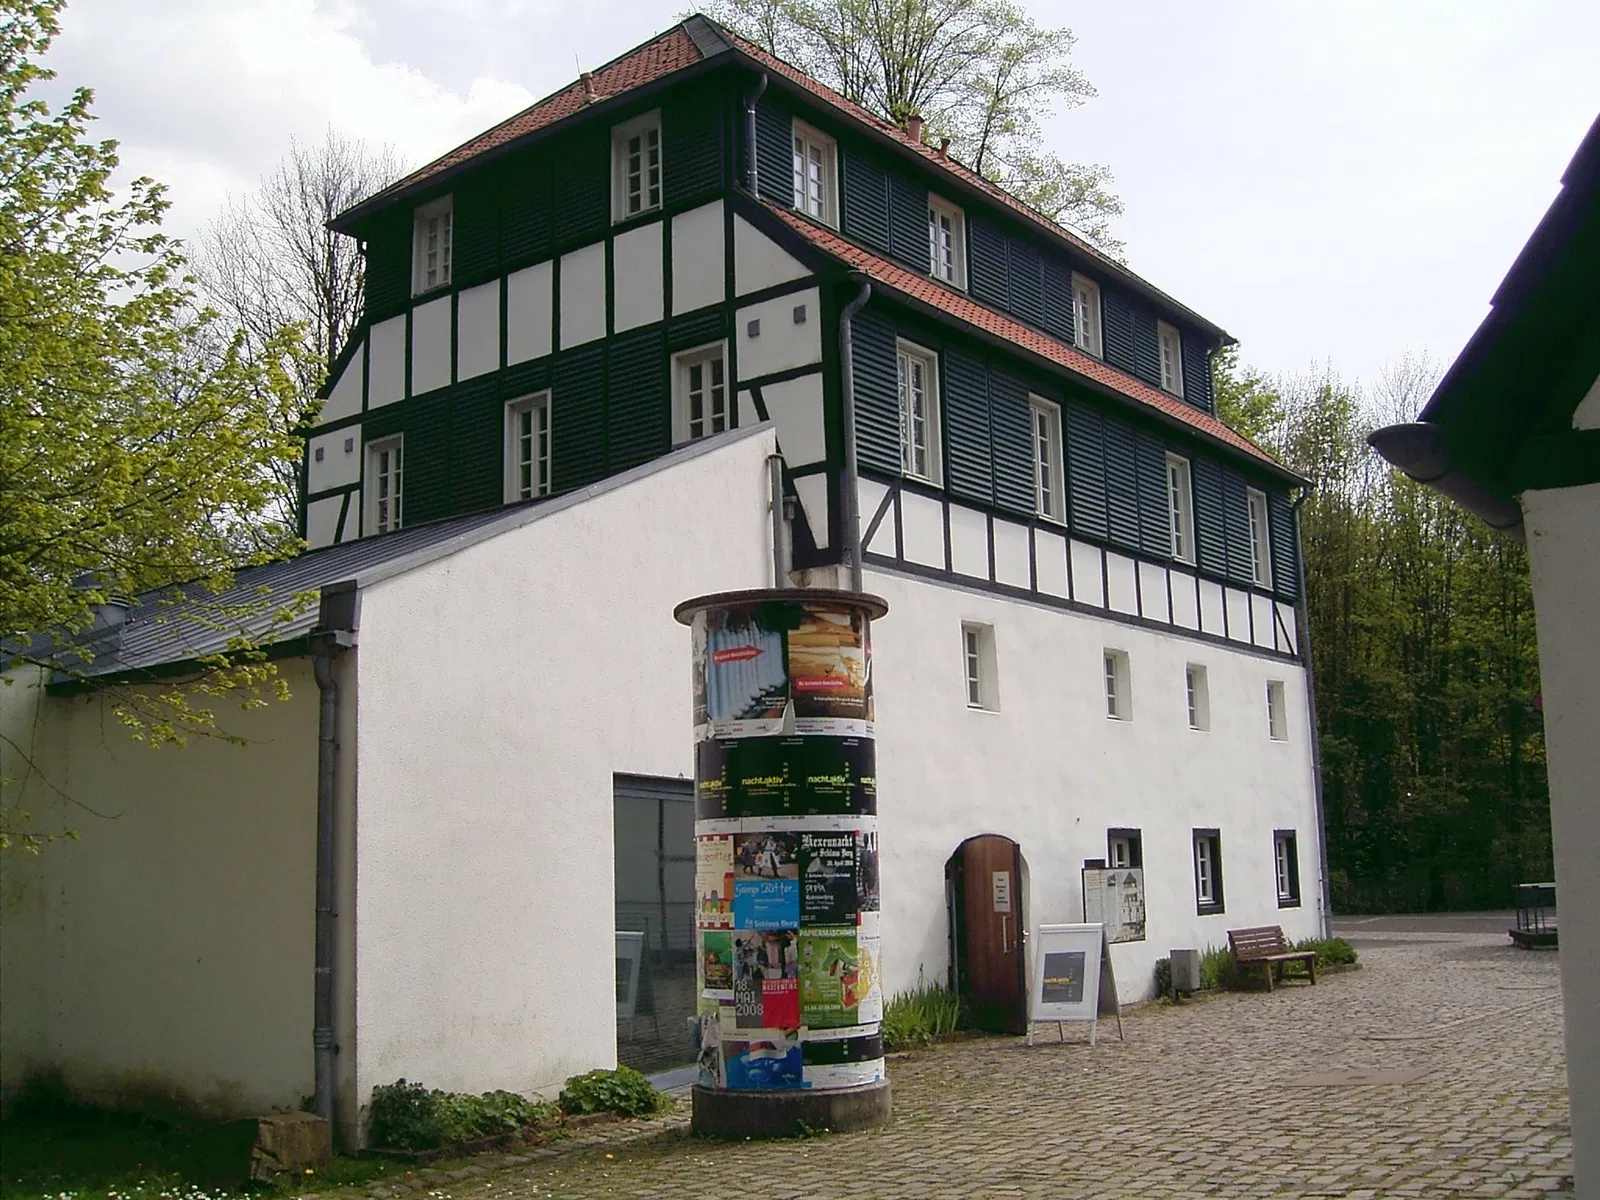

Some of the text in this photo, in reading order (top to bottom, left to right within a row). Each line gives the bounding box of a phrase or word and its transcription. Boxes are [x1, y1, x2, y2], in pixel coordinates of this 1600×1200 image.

[741, 775, 784, 786] nacht.aktiv
[808, 775, 846, 785] nacht.aktiv
[801, 834, 853, 852] Hexennacht
[735, 980, 751, 991] 18.
[735, 991, 756, 1003] MAI
[736, 1004, 764, 1016] 2008
